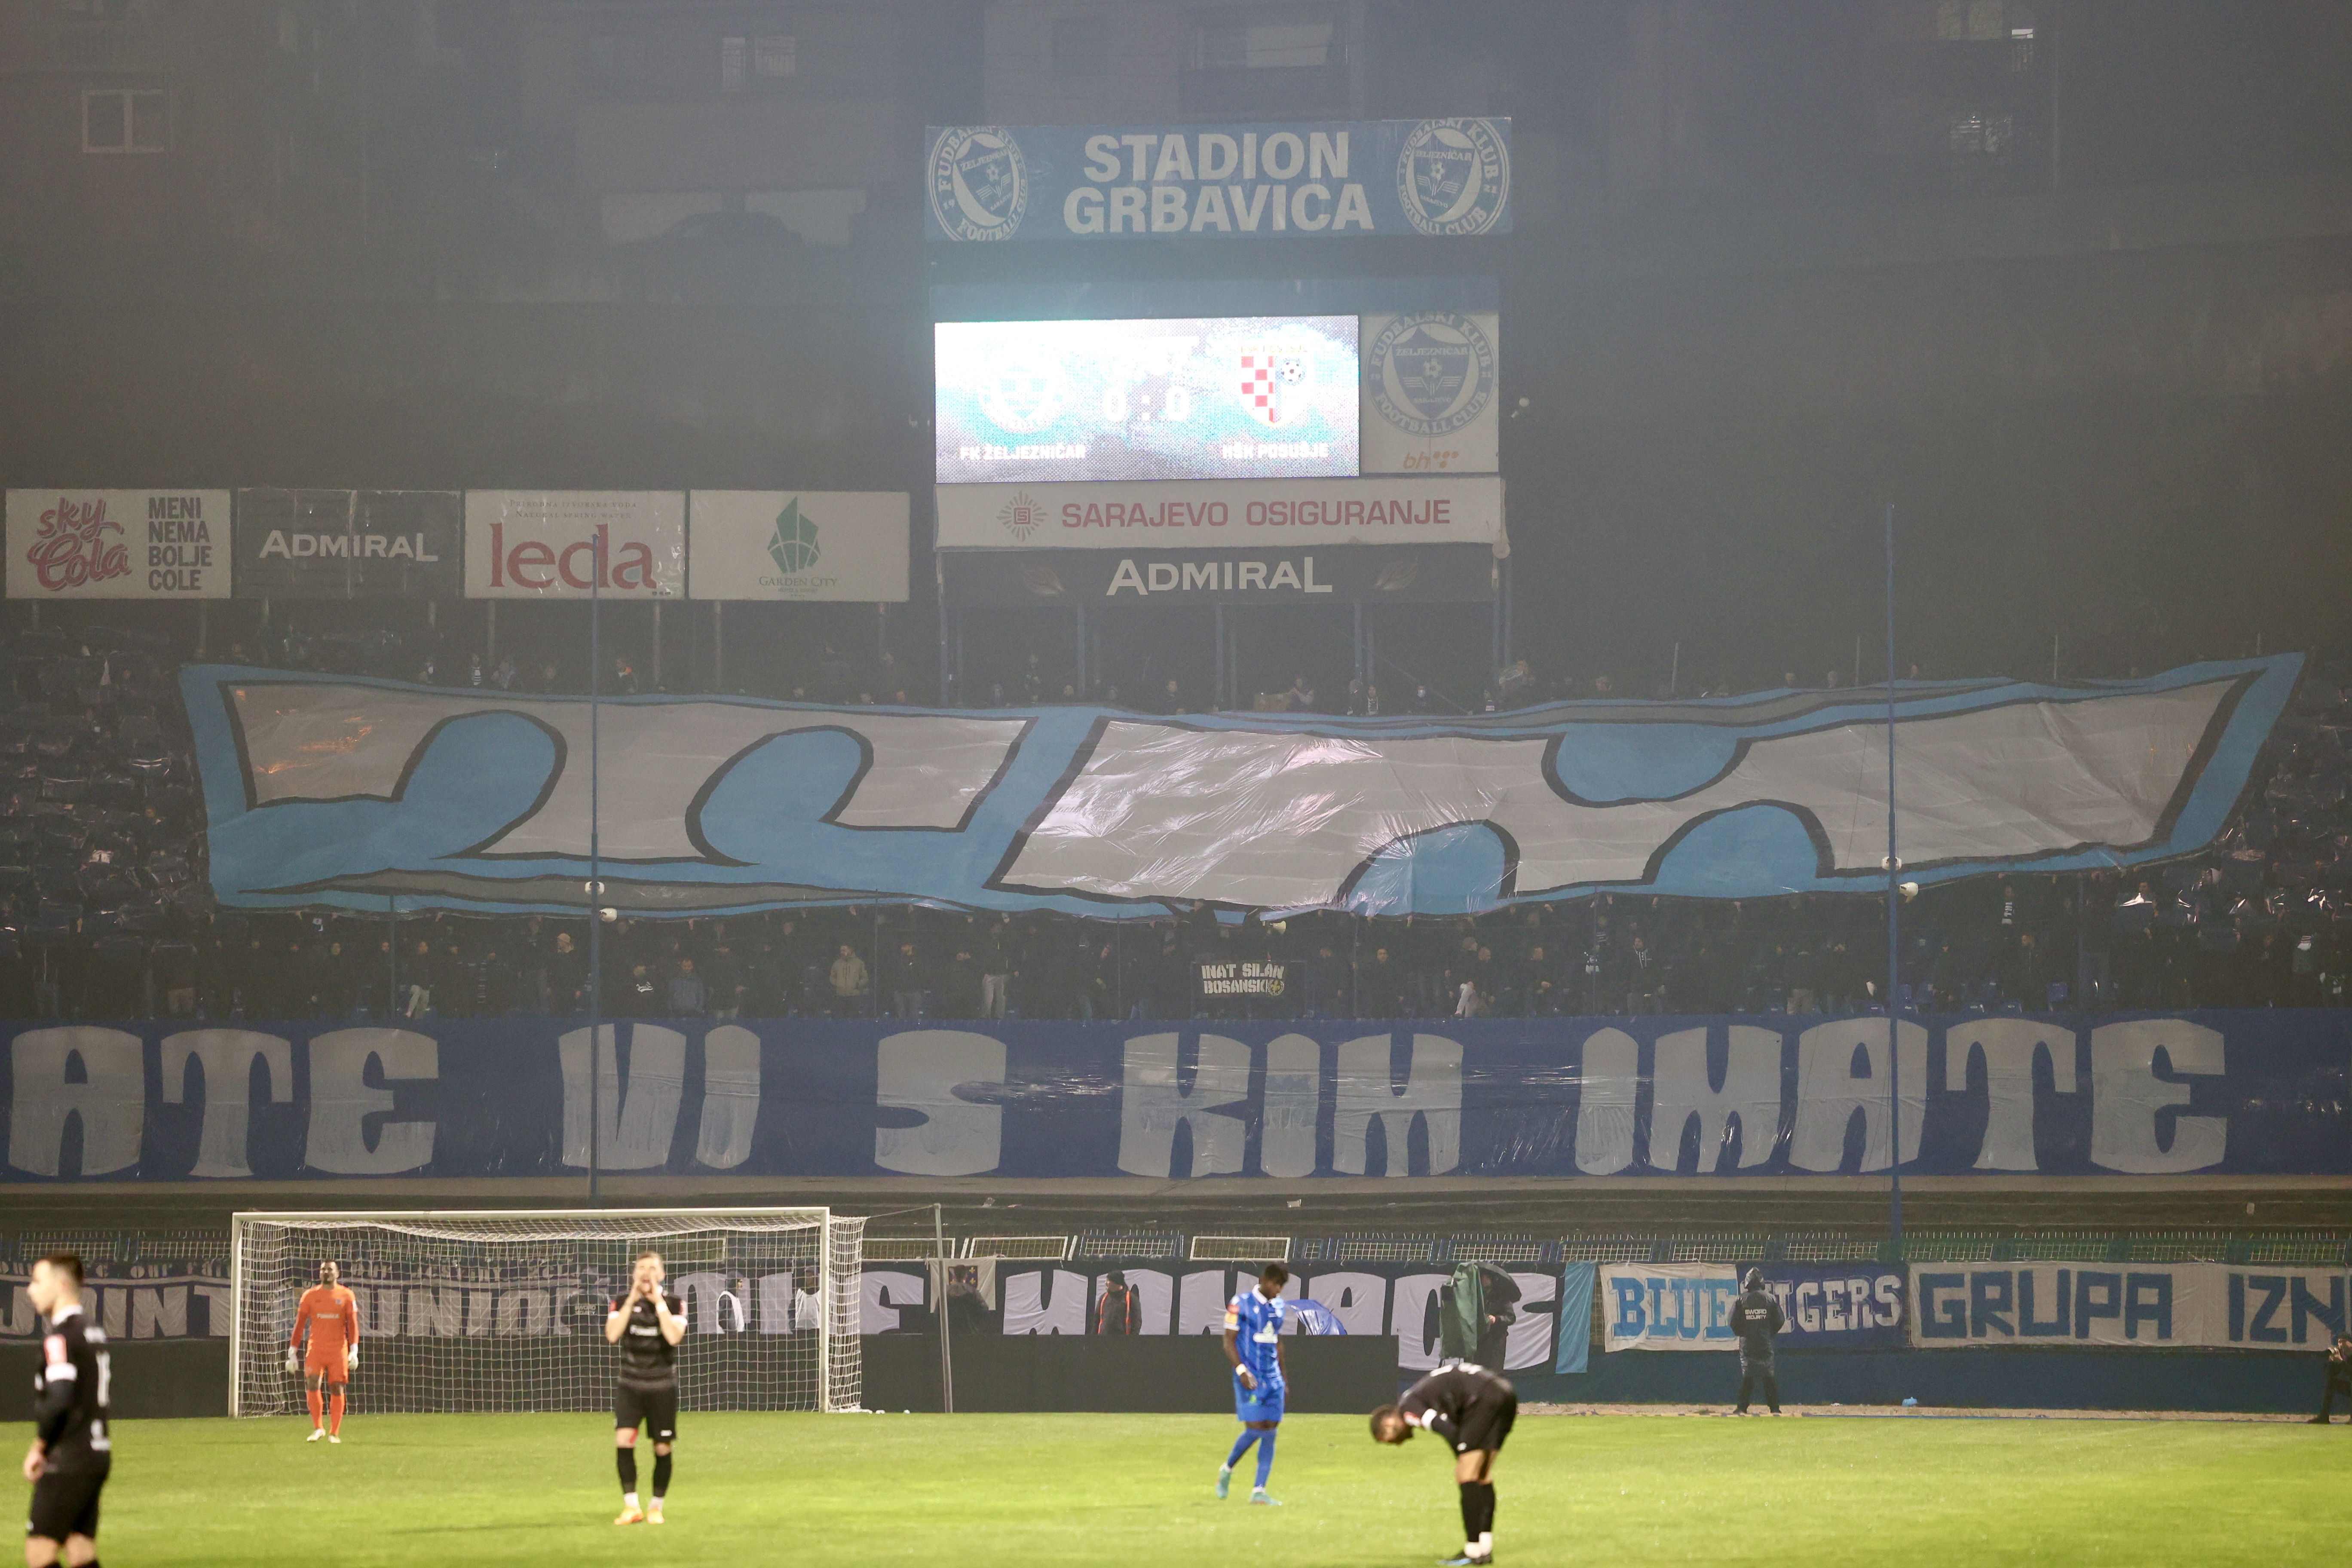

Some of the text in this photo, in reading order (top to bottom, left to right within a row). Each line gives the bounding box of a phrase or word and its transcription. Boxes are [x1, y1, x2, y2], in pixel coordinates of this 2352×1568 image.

[1083, 132, 1349, 182] STADION
[1466, 123, 1500, 179] KLUB
[1063, 184, 1375, 234] GRBAVICA
[1445, 206, 1487, 236] CLUB
[1459, 321, 1491, 368] KLUB
[1375, 391, 1487, 433] FOOTBALL CLUB
[960, 442, 1086, 460] FK ŽELJEZNIČAR
[1258, 440, 1329, 459] POSUŠJE
[148, 497, 202, 519] MENI
[1062, 502, 1228, 528] SARAJEVO
[1246, 499, 1450, 526] OSIGURANJE
[148, 521, 210, 543] NEMA
[259, 530, 438, 562] ADMIRAL
[27, 533, 132, 591] Cola
[148, 545, 212, 567] BOLJE
[489, 522, 657, 590] leda
[148, 570, 201, 591] COLE
[1106, 557, 1333, 596] ADMIRAL
[1201, 963, 1285, 979] INAT SILAN
[1203, 979, 1268, 994] BOSANSKI
[8, 1017, 2228, 1178] ATE VI S KIM IMATE
[1608, 1277, 1740, 1341] BLUE
[1740, 1275, 1902, 1333] IGERS
[1919, 1268, 2352, 1346] GRUPA IZN
